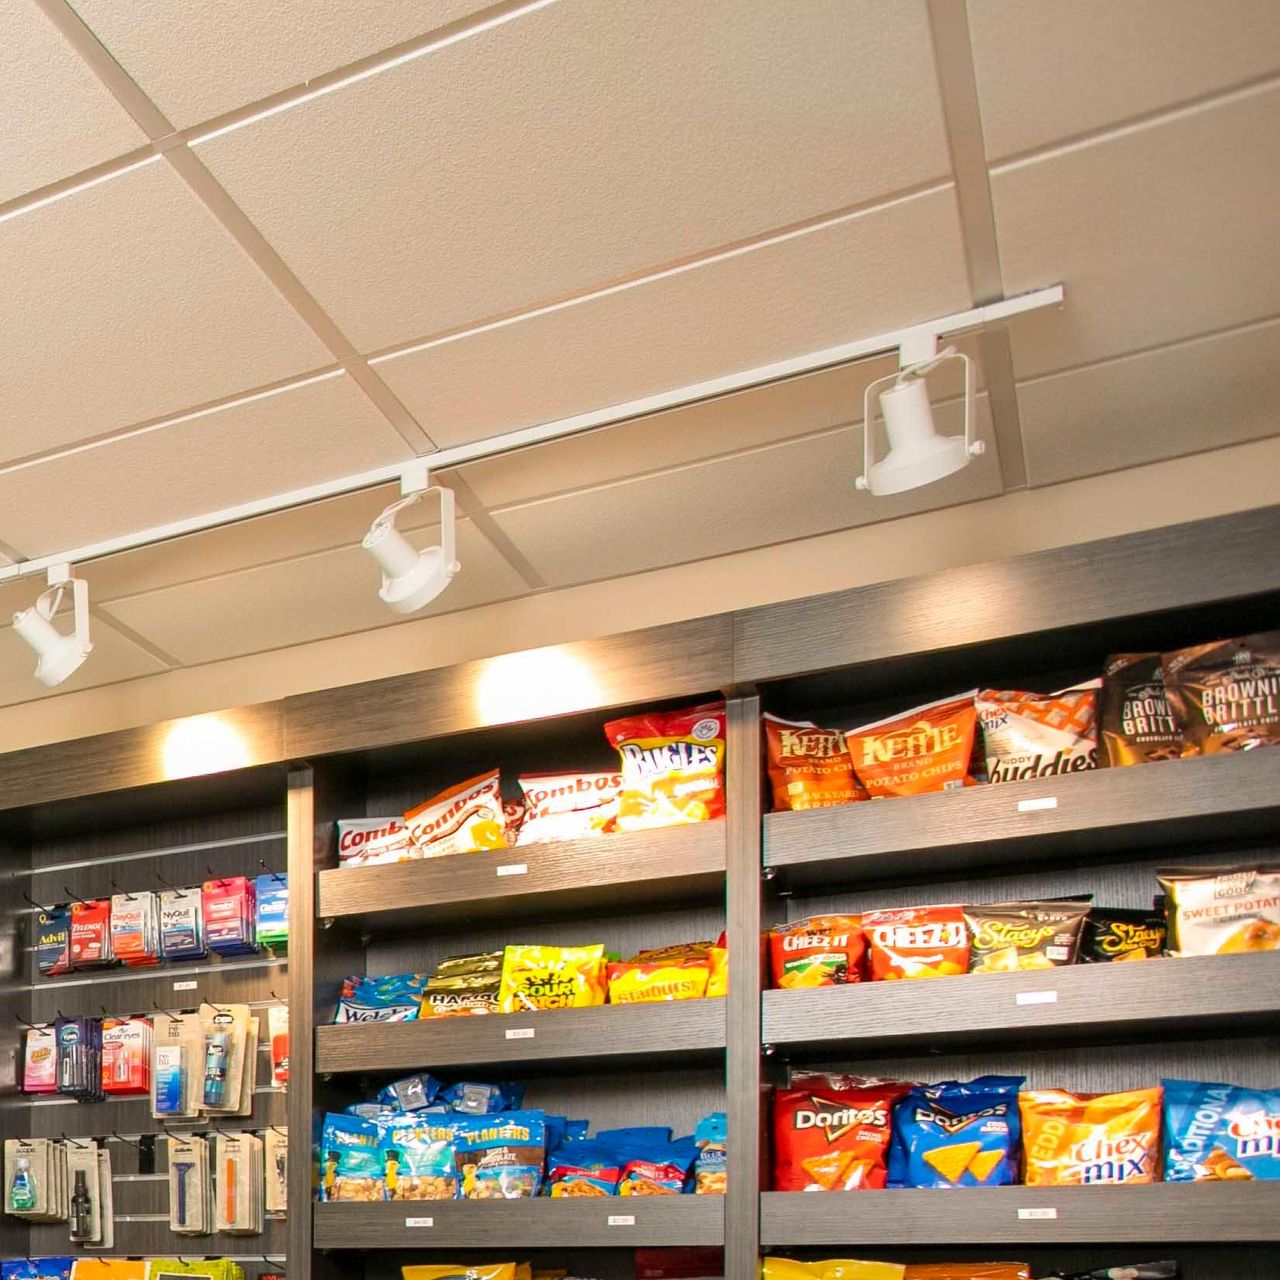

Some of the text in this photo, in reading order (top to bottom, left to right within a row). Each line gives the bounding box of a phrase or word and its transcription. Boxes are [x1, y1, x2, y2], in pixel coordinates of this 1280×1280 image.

[861, 721, 963, 767] KETTLE
[622, 742, 719, 778] BUGLES
[785, 766, 831, 776] POTATO
[893, 757, 933, 771] BRAND
[990, 750, 1097, 784] buddies
[866, 761, 963, 788] POTATO CHIPS
[525, 774, 624, 806] Combos
[412, 781, 495, 841] Combos
[112, 912, 142, 921] DayQuil
[163, 910, 190, 919] NyQuil
[1182, 899, 1280, 921] SWEET POTAT
[40, 932, 65, 944] Advil
[71, 922, 104, 932] TYLENOL
[517, 982, 574, 997] SOUR
[617, 980, 695, 1004] Starburst
[103, 1032, 141, 1041] Clear eyes
[796, 1108, 888, 1129] Doritos
[1075, 1132, 1151, 1163] Chex
[1085, 1153, 1147, 1184] mix
